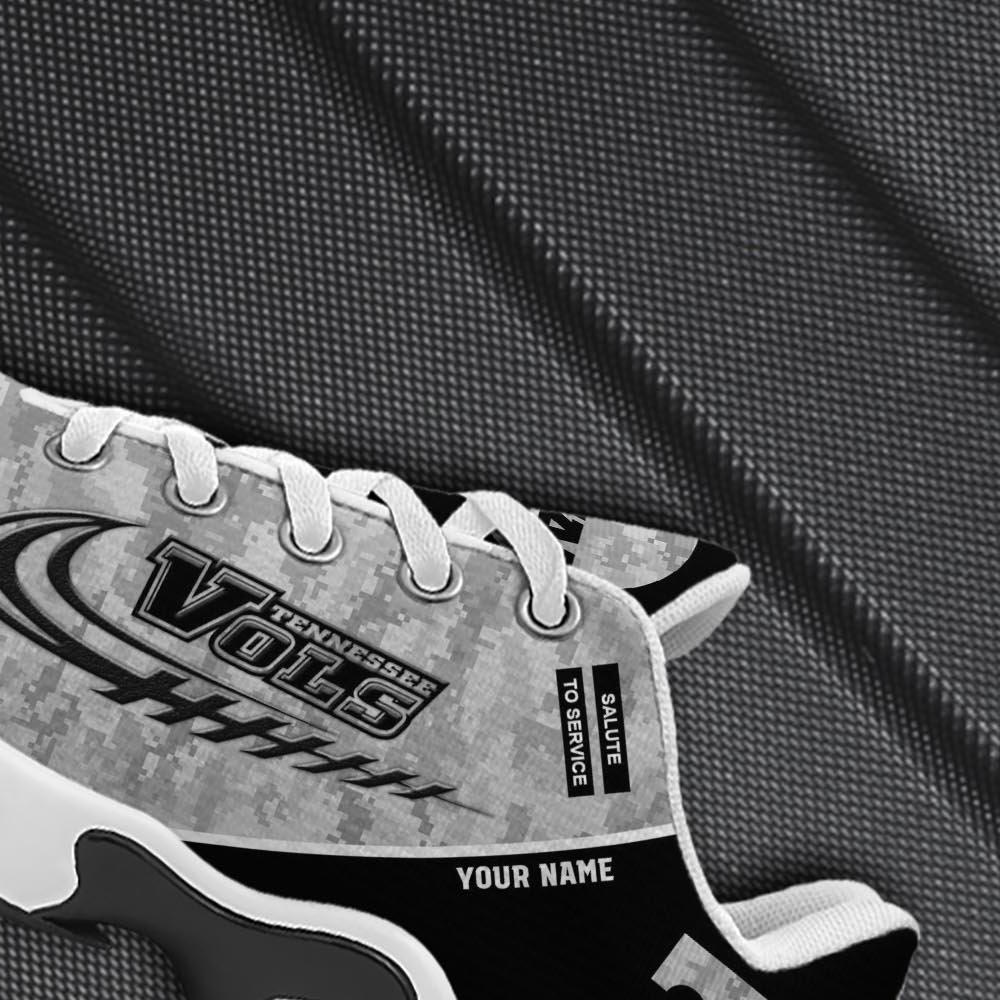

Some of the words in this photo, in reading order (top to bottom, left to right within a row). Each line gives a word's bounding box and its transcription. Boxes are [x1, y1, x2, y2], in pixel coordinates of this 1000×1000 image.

[131, 534, 430, 740] VOLS
[270, 603, 438, 697] TENNESSEE
[562, 677, 579, 704] TO
[601, 692, 622, 766] SALUTE
[566, 707, 588, 787] SERVICE
[456, 864, 530, 891] YOUR
[538, 857, 615, 888] NAME
